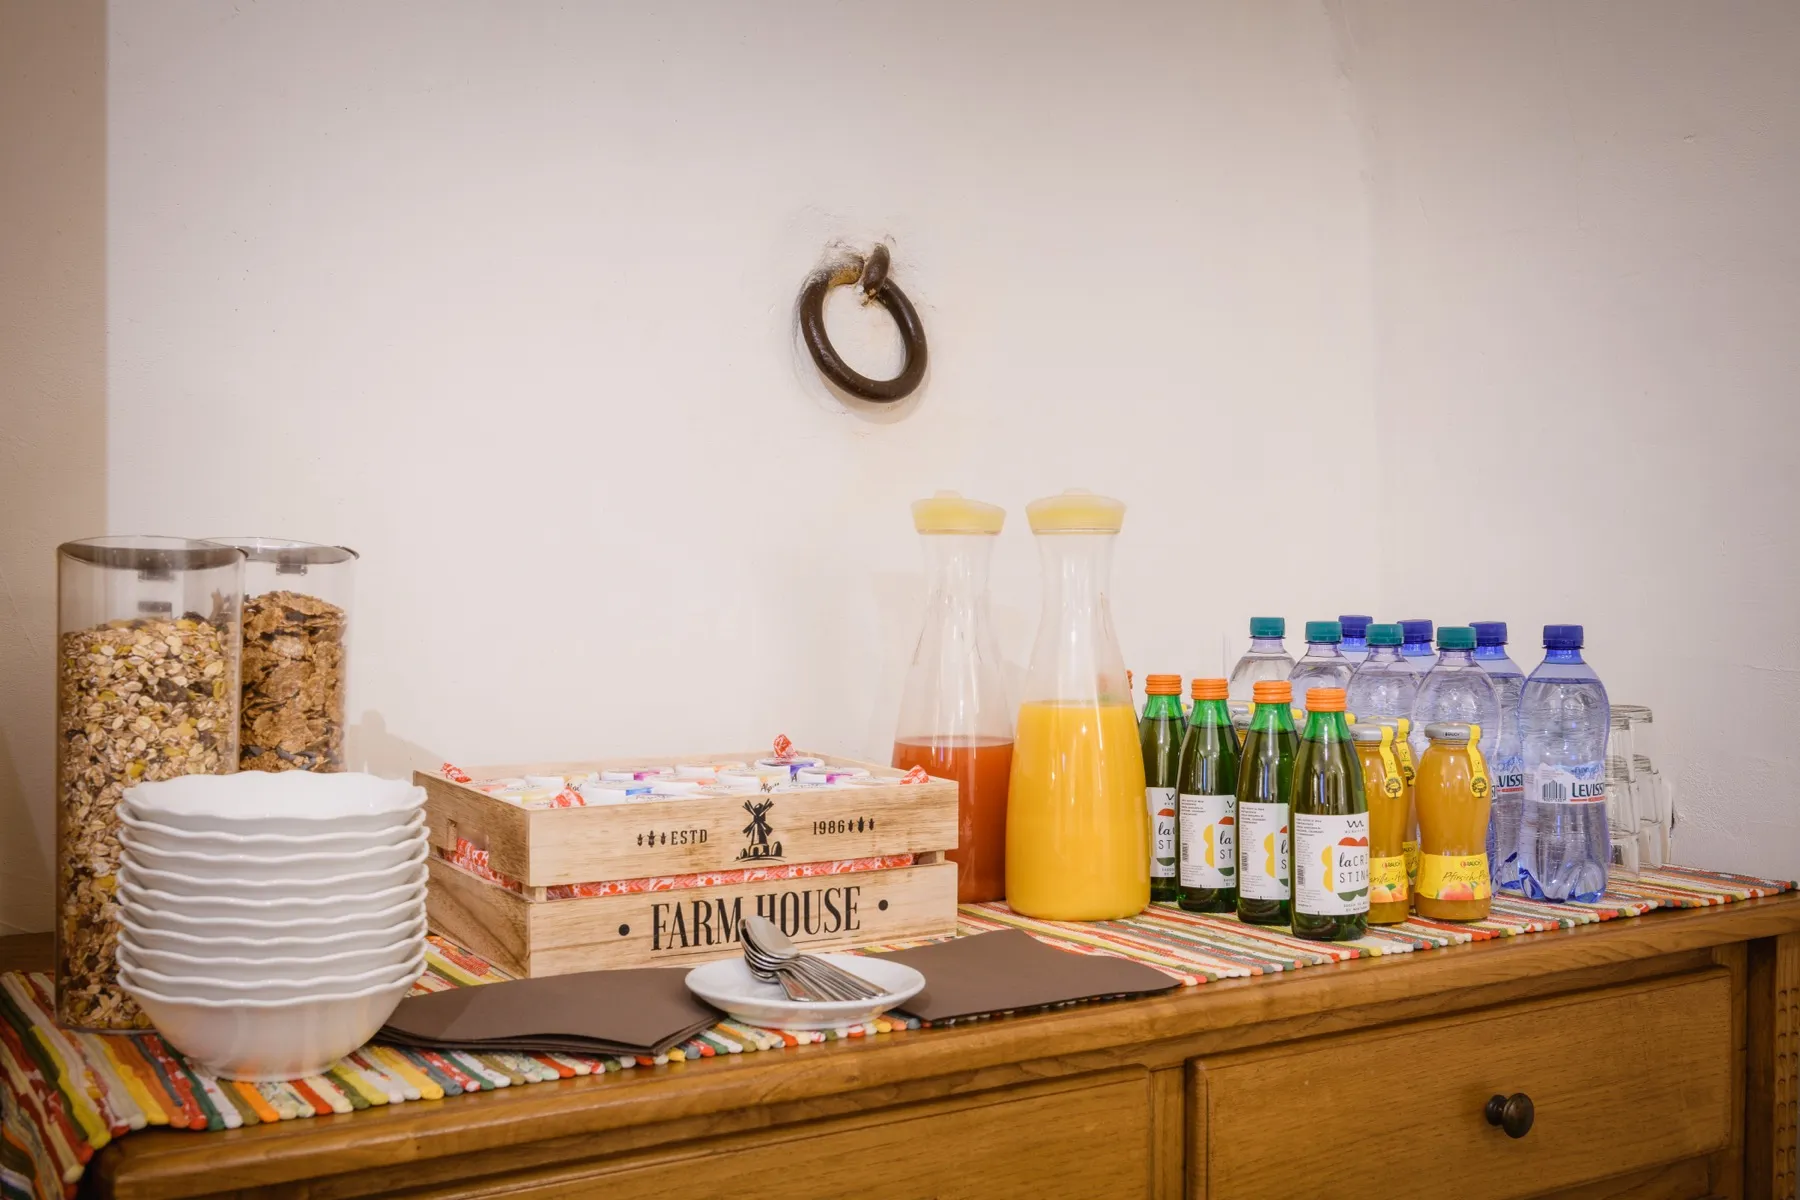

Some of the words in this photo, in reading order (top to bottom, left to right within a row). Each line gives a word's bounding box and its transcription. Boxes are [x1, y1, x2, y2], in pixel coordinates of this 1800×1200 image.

[813, 820, 845, 836] 1986
[671, 829, 708, 846] ESTD
[651, 896, 744, 951] FARM
[756, 885, 861, 939] HOUSE
